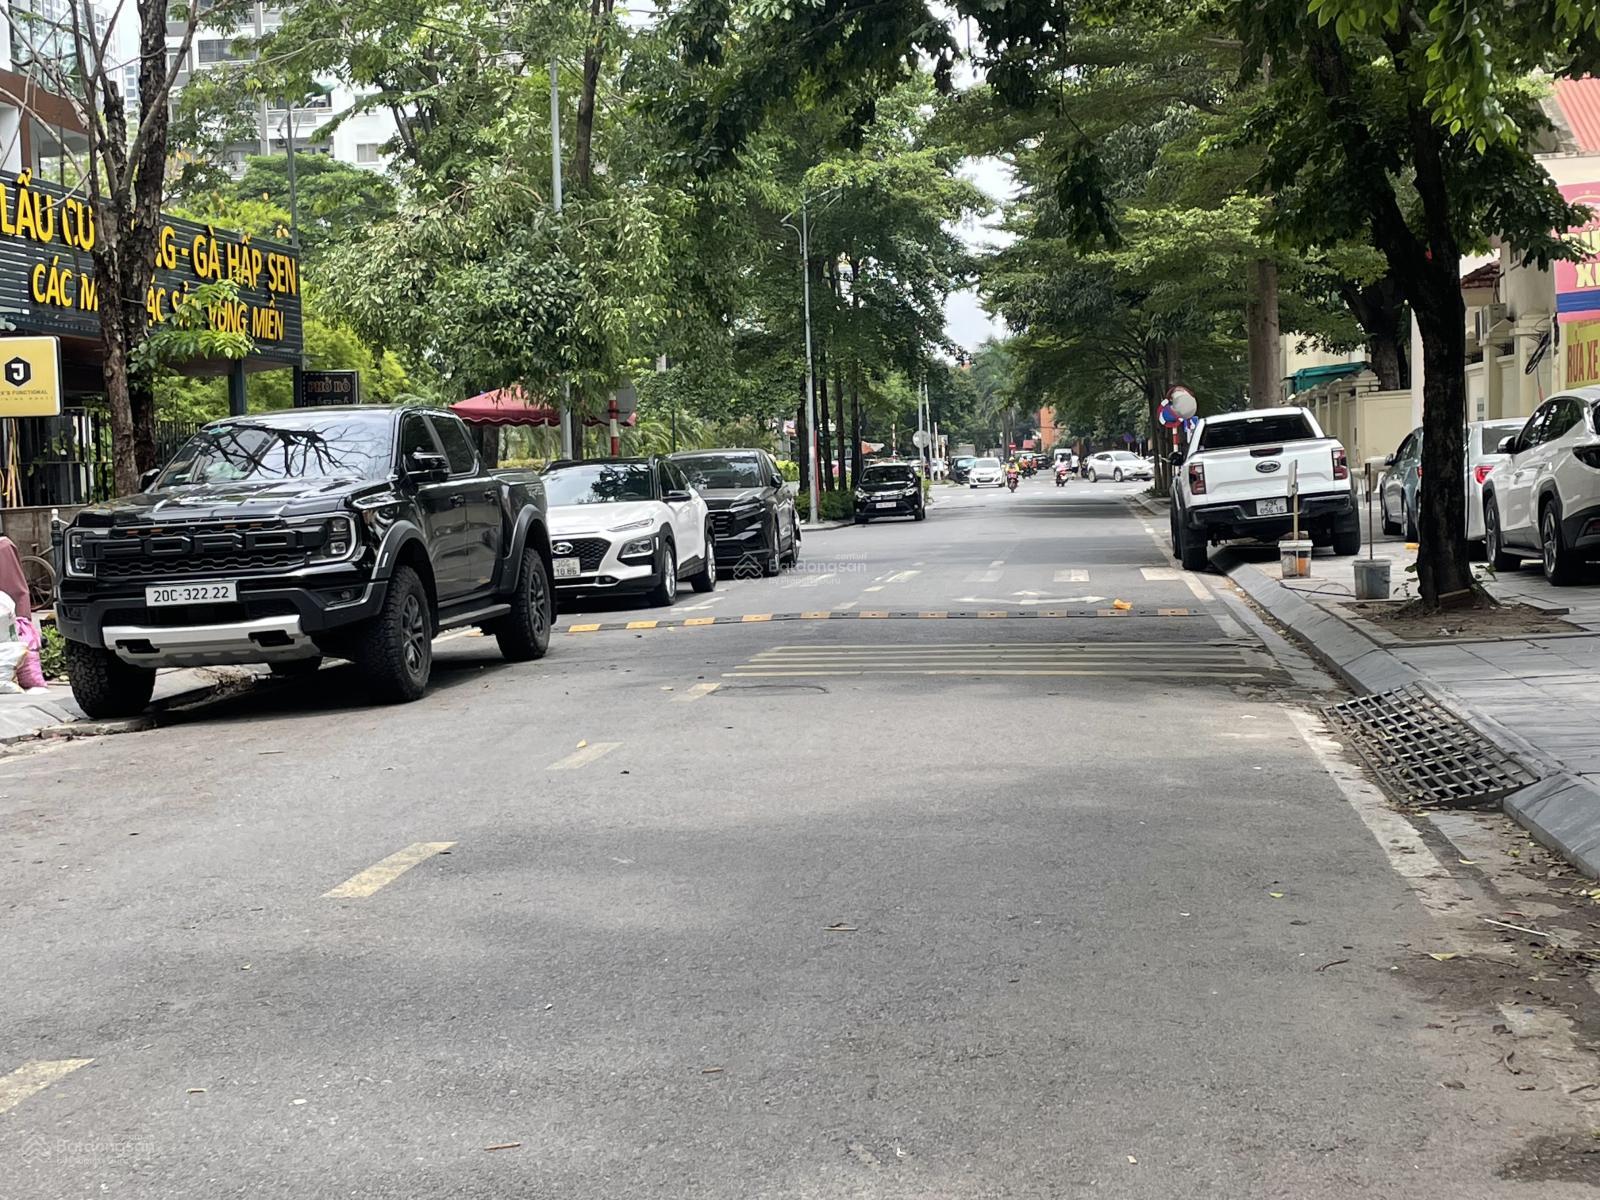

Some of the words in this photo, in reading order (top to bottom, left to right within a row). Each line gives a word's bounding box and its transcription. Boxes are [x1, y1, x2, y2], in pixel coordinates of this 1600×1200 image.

[193, 225, 221, 279] GÀ
[268, 252, 296, 296] SEN
[32, 255, 73, 307] CÁC
[252, 293, 284, 340] MIỀN
[11, 363, 24, 380] J
[153, 586, 229, 603] 20C-322.22
